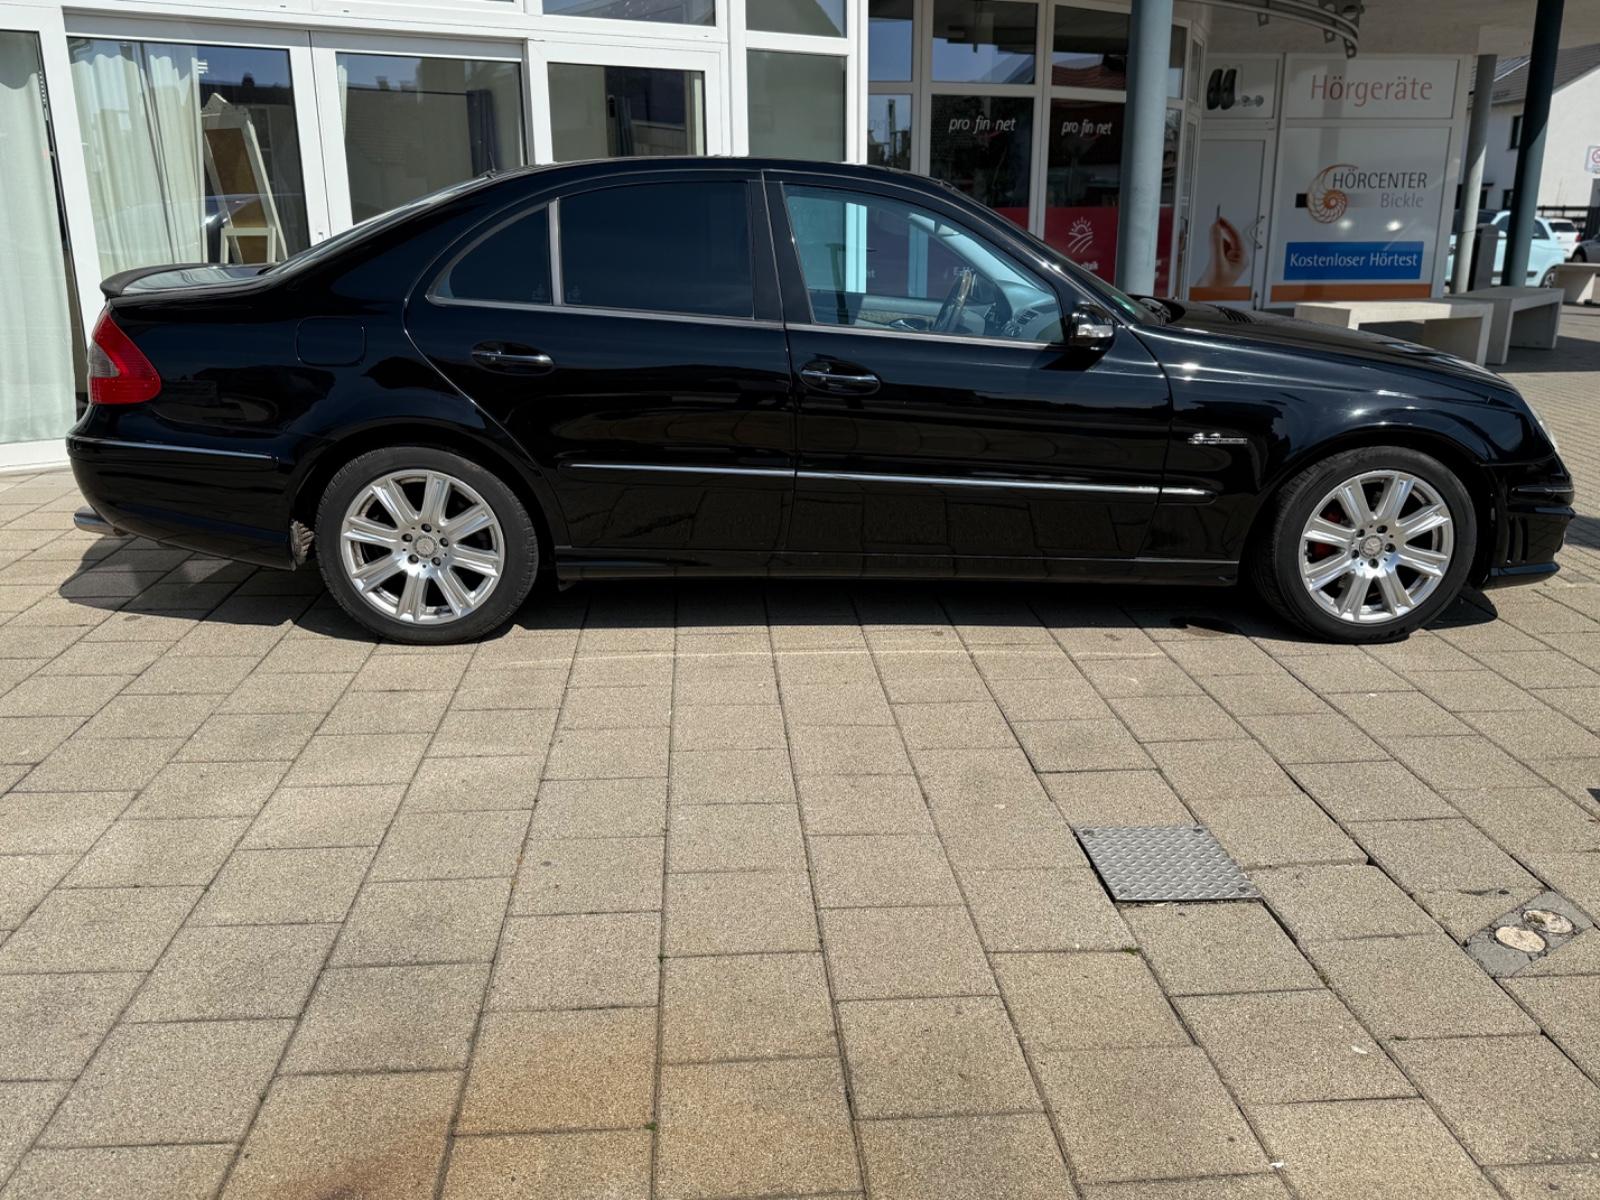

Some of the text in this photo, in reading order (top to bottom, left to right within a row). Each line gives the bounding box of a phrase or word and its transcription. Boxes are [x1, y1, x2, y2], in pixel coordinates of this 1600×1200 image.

[1310, 74, 1433, 107] Hörgeräte
[949, 115, 1016, 134] pro fin net
[1061, 119, 1112, 137] pro fin net
[1332, 168, 1428, 189] HÖRCENTER
[1380, 192, 1425, 208] Bickle
[1289, 252, 1418, 268] Kostenloser Hörtest
